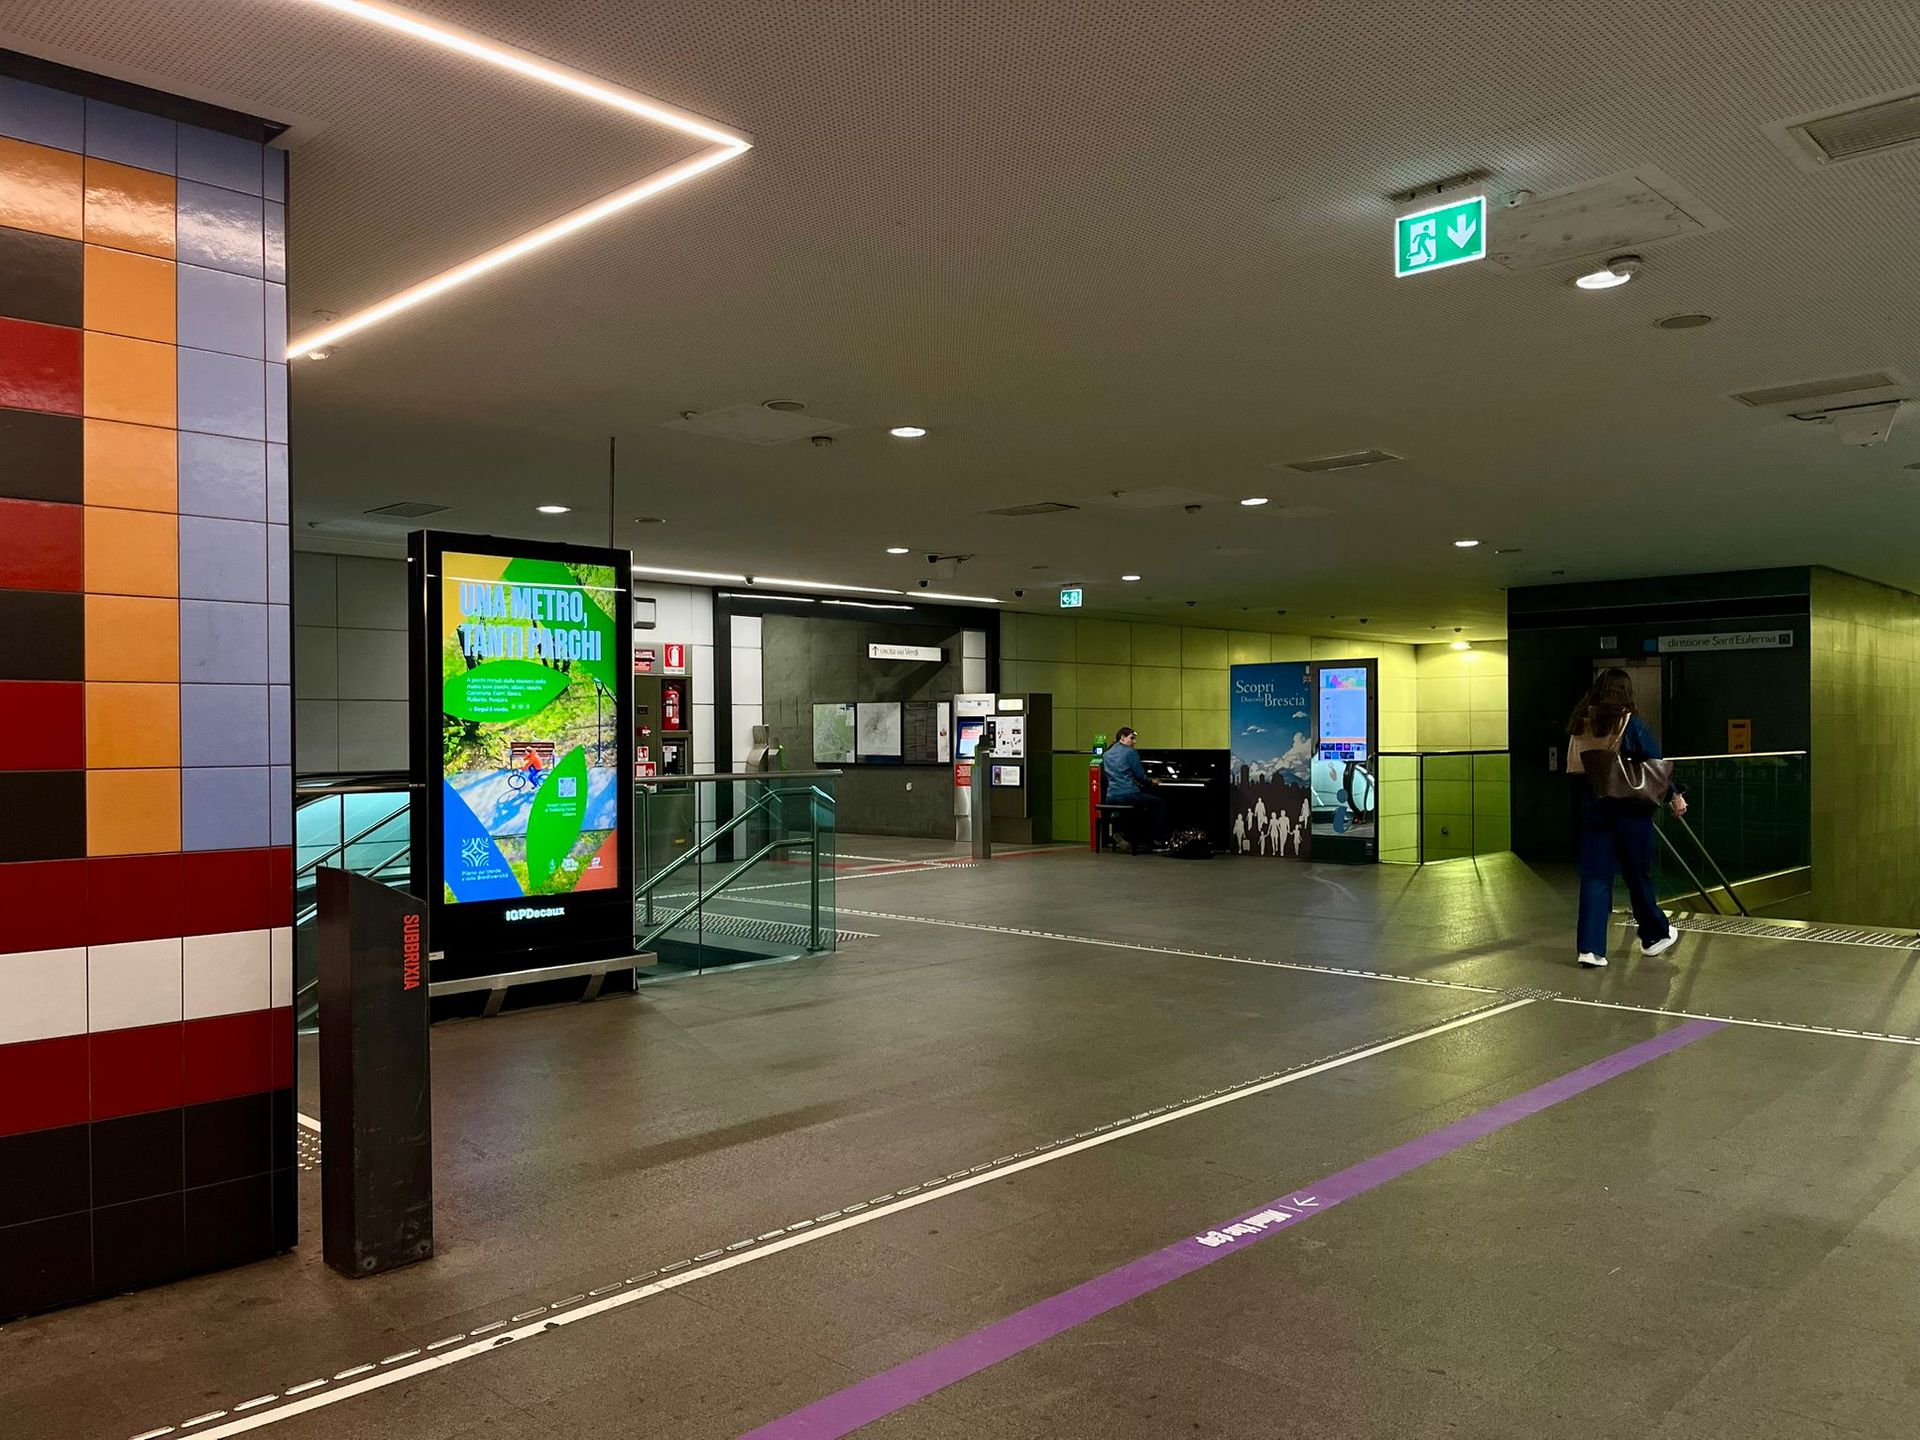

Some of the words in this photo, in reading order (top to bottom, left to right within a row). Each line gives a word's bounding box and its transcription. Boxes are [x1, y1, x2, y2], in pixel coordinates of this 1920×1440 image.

[460, 583, 506, 617] UNA
[511, 586, 588, 628] METRO,
[463, 624, 524, 659] TANTI
[528, 628, 602, 661] PARCHI
[1668, 636, 1710, 647] direzione
[1236, 679, 1274, 697] Scopri
[1264, 693, 1305, 707] Brescia
[505, 907, 565, 921] IGPDecaux
[404, 914, 420, 990] SUBBRIXIA
